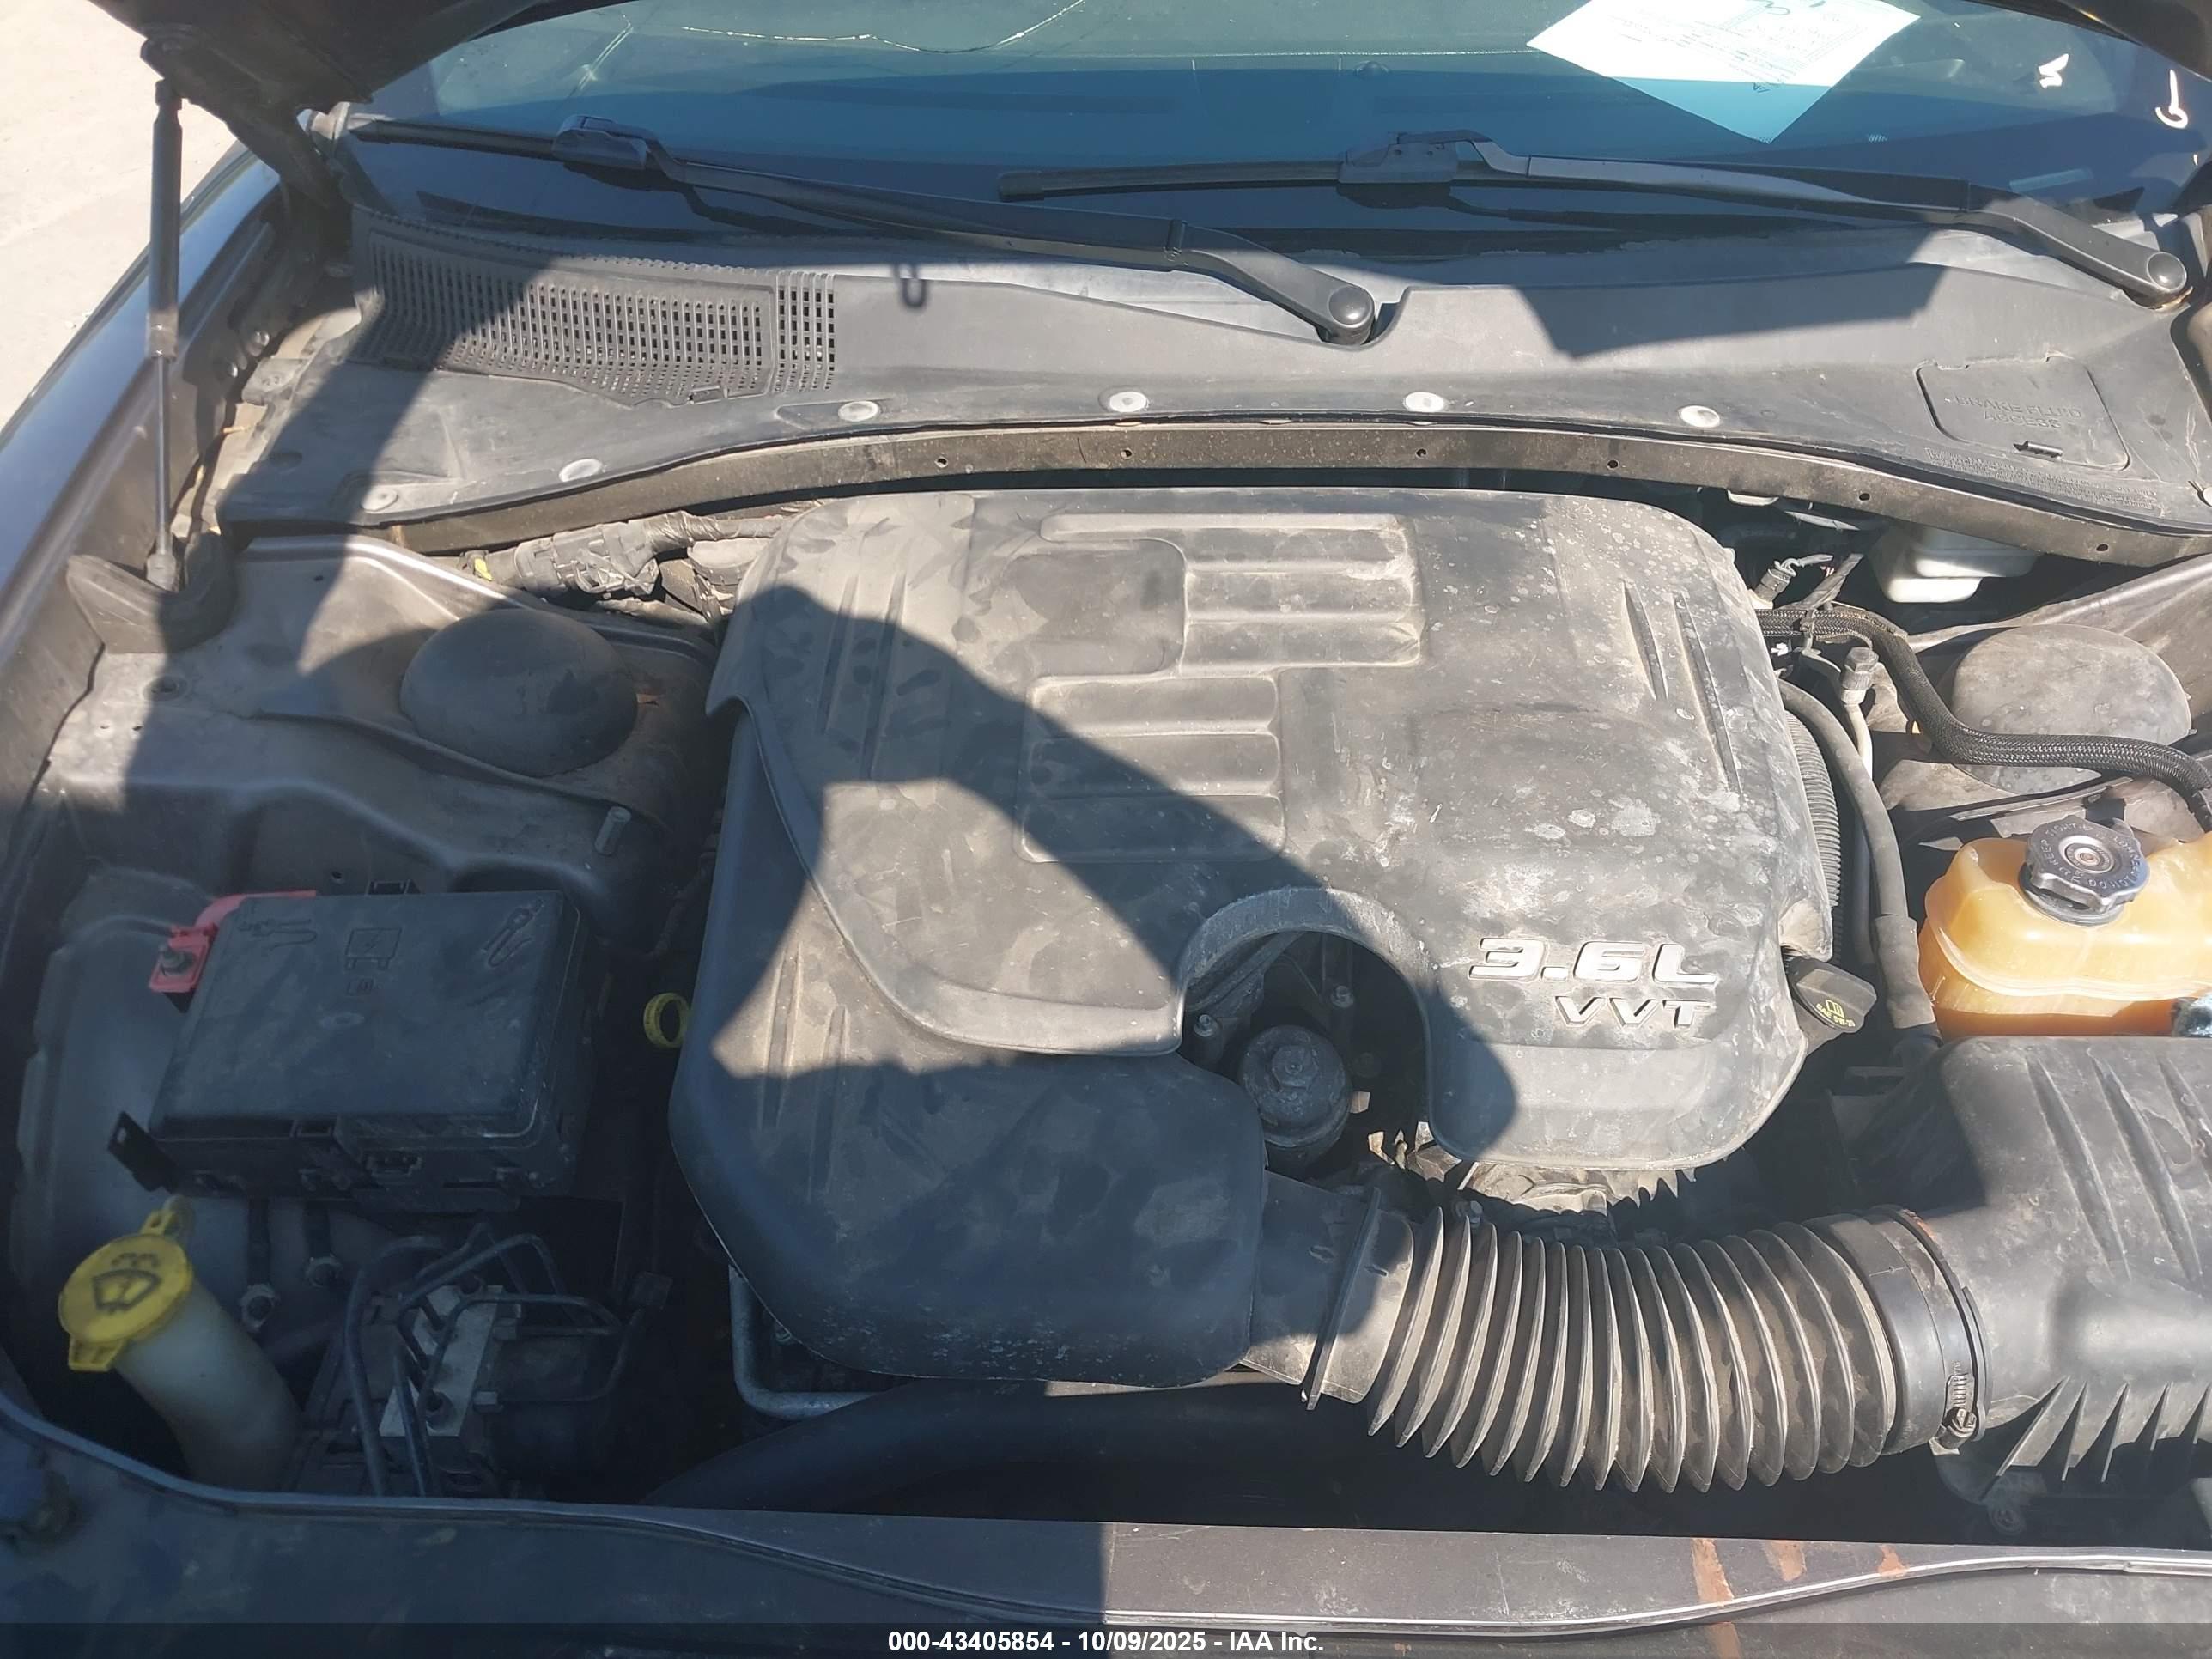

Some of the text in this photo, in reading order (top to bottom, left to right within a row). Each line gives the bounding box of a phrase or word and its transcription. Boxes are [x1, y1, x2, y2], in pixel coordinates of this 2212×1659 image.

[1954, 396, 2023, 413] BRAKE
[1984, 410, 2062, 428] ACCESS
[2040, 839, 2060, 866] KEEP
[1468, 937, 1716, 983] 3.6L
[1555, 996, 1711, 1030] VVT
